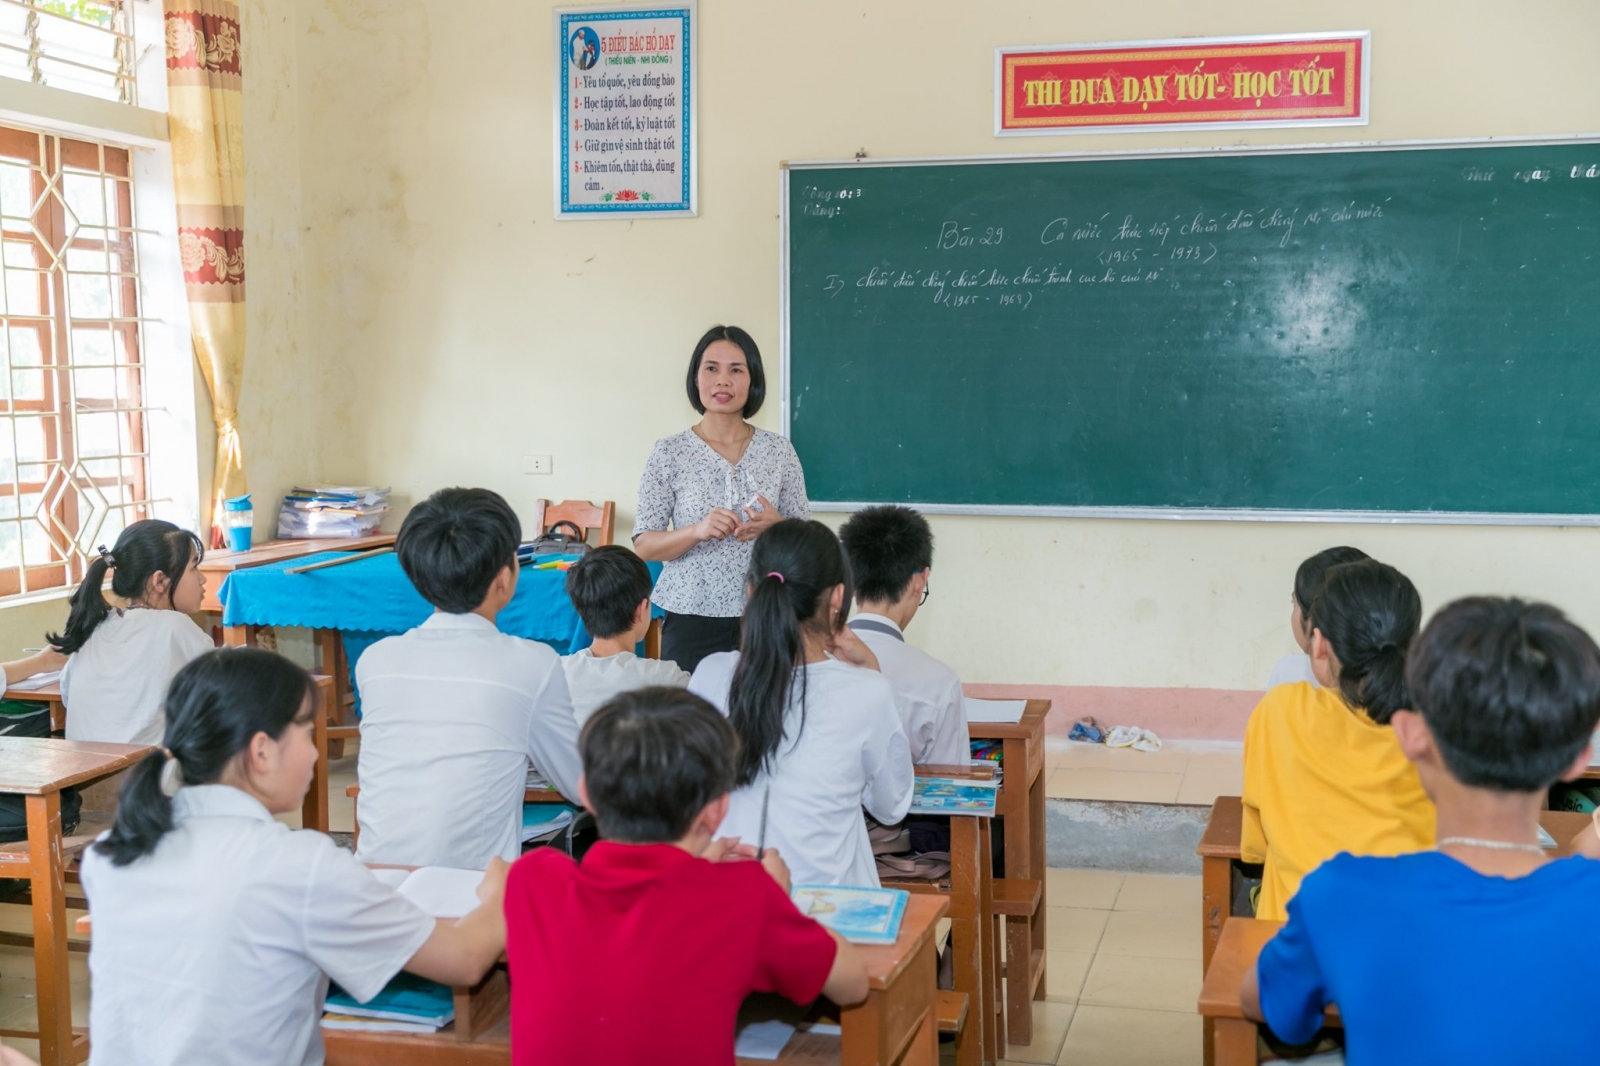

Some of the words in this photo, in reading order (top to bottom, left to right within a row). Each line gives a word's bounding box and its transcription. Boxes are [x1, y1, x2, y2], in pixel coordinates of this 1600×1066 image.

[601, 36, 607, 53] 5
[608, 28, 627, 52] ĐIỀU
[629, 31, 645, 51] BÁC
[646, 27, 658, 51] HỒ
[623, 55, 636, 65] NIÊN
[640, 56, 650, 65] NHI
[583, 75, 596, 88] Yêu
[599, 72, 606, 87] tổ
[607, 73, 626, 90] quốc,
[628, 74, 640, 89] yêu
[642, 71, 660, 88] đồng
[662, 73, 675, 86] bào
[1023, 79, 1063, 106] THI
[1069, 77, 1116, 104] ĐUA
[1122, 75, 1170, 111] DẠY
[1233, 70, 1282, 108] HỌC
[1288, 55, 1335, 96] TỐT
[584, 96, 599, 112] Học
[601, 96, 613, 111] tập
[615, 94, 628, 110] tốt,
[629, 95, 641, 108] lao
[643, 94, 662, 110] động
[664, 92, 675, 106] tốt
[584, 118, 605, 131] Đoàn
[606, 116, 619, 130] kết
[621, 115, 634, 132] tốt,
[636, 115, 645, 132] kỷ
[647, 116, 662, 132] luật
[664, 114, 675, 129] tốt
[584, 138, 600, 151] Giữ
[601, 139, 614, 154] gìn
[614, 138, 624, 154] vệ
[625, 137, 643, 151] sinh
[644, 137, 661, 153] thật
[663, 135, 675, 149] tốt
[584, 160, 607, 173] Khiêm
[609, 158, 623, 176] tốn,
[623, 159, 639, 175] thật
[640, 159, 654, 174] thà,
[655, 159, 675, 174] dũng
[856, 188, 862, 199] 3
[979, 226, 1003, 245] 29
